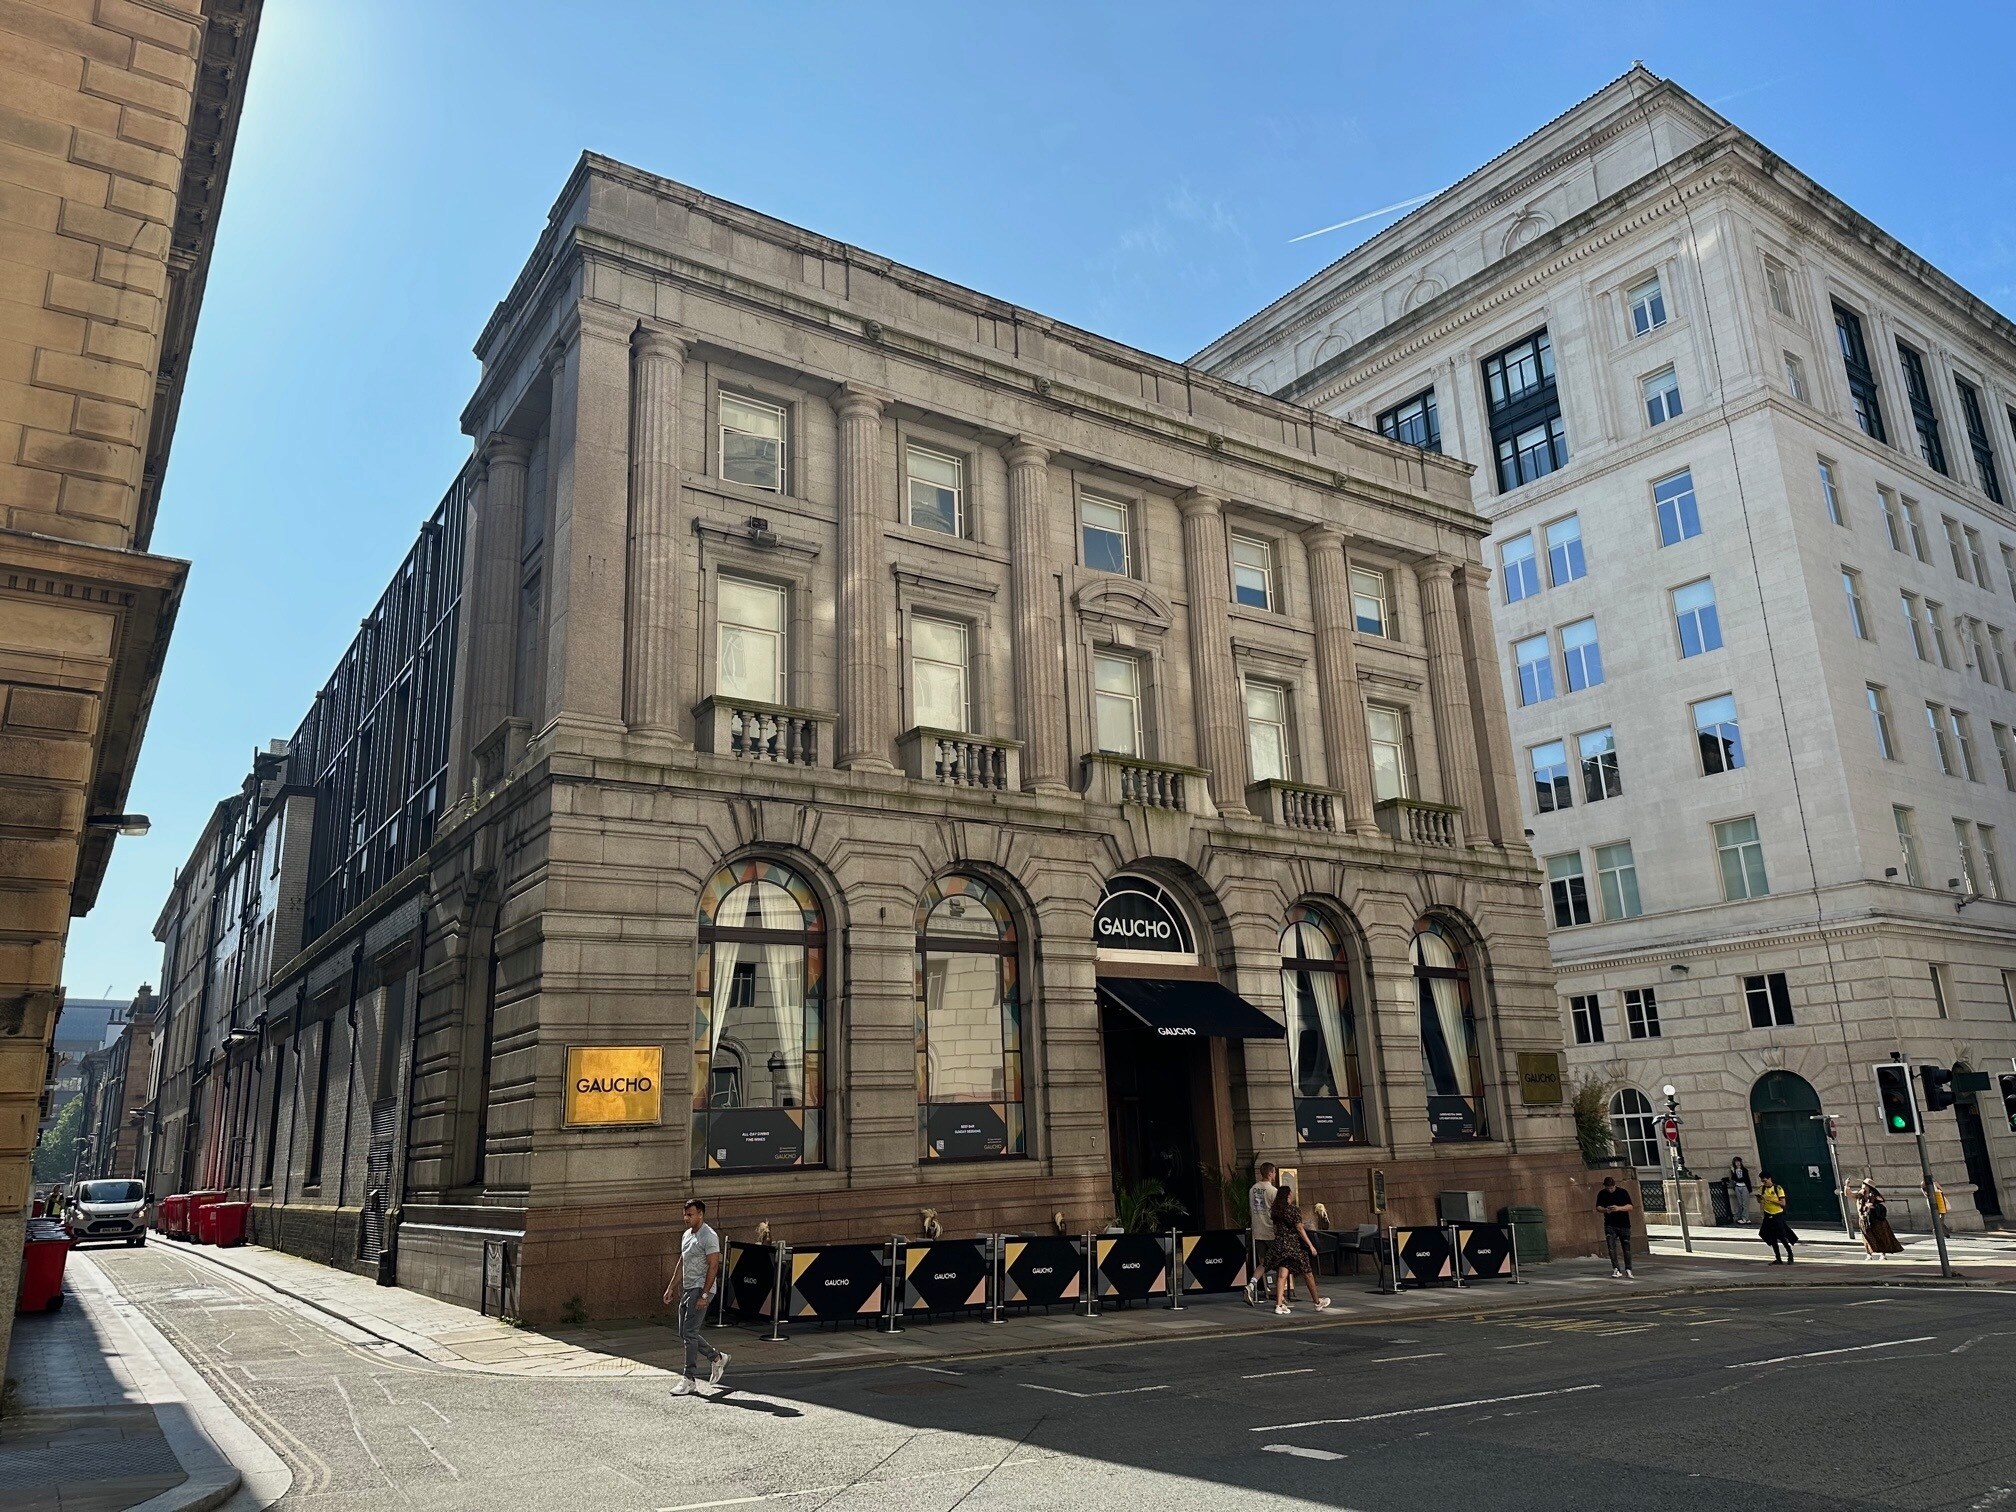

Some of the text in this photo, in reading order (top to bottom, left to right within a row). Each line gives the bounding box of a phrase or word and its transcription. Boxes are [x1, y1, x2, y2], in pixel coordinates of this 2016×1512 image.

[1098, 917, 1171, 939] GAUCHO
[1158, 1027, 1196, 1035] GAUCHO
[1525, 1073, 1557, 1083] GAUCHO
[576, 1077, 652, 1093] GAUCHO
[743, 1276, 757, 1284] GAUCHO
[934, 1272, 956, 1280] GAUCHO
